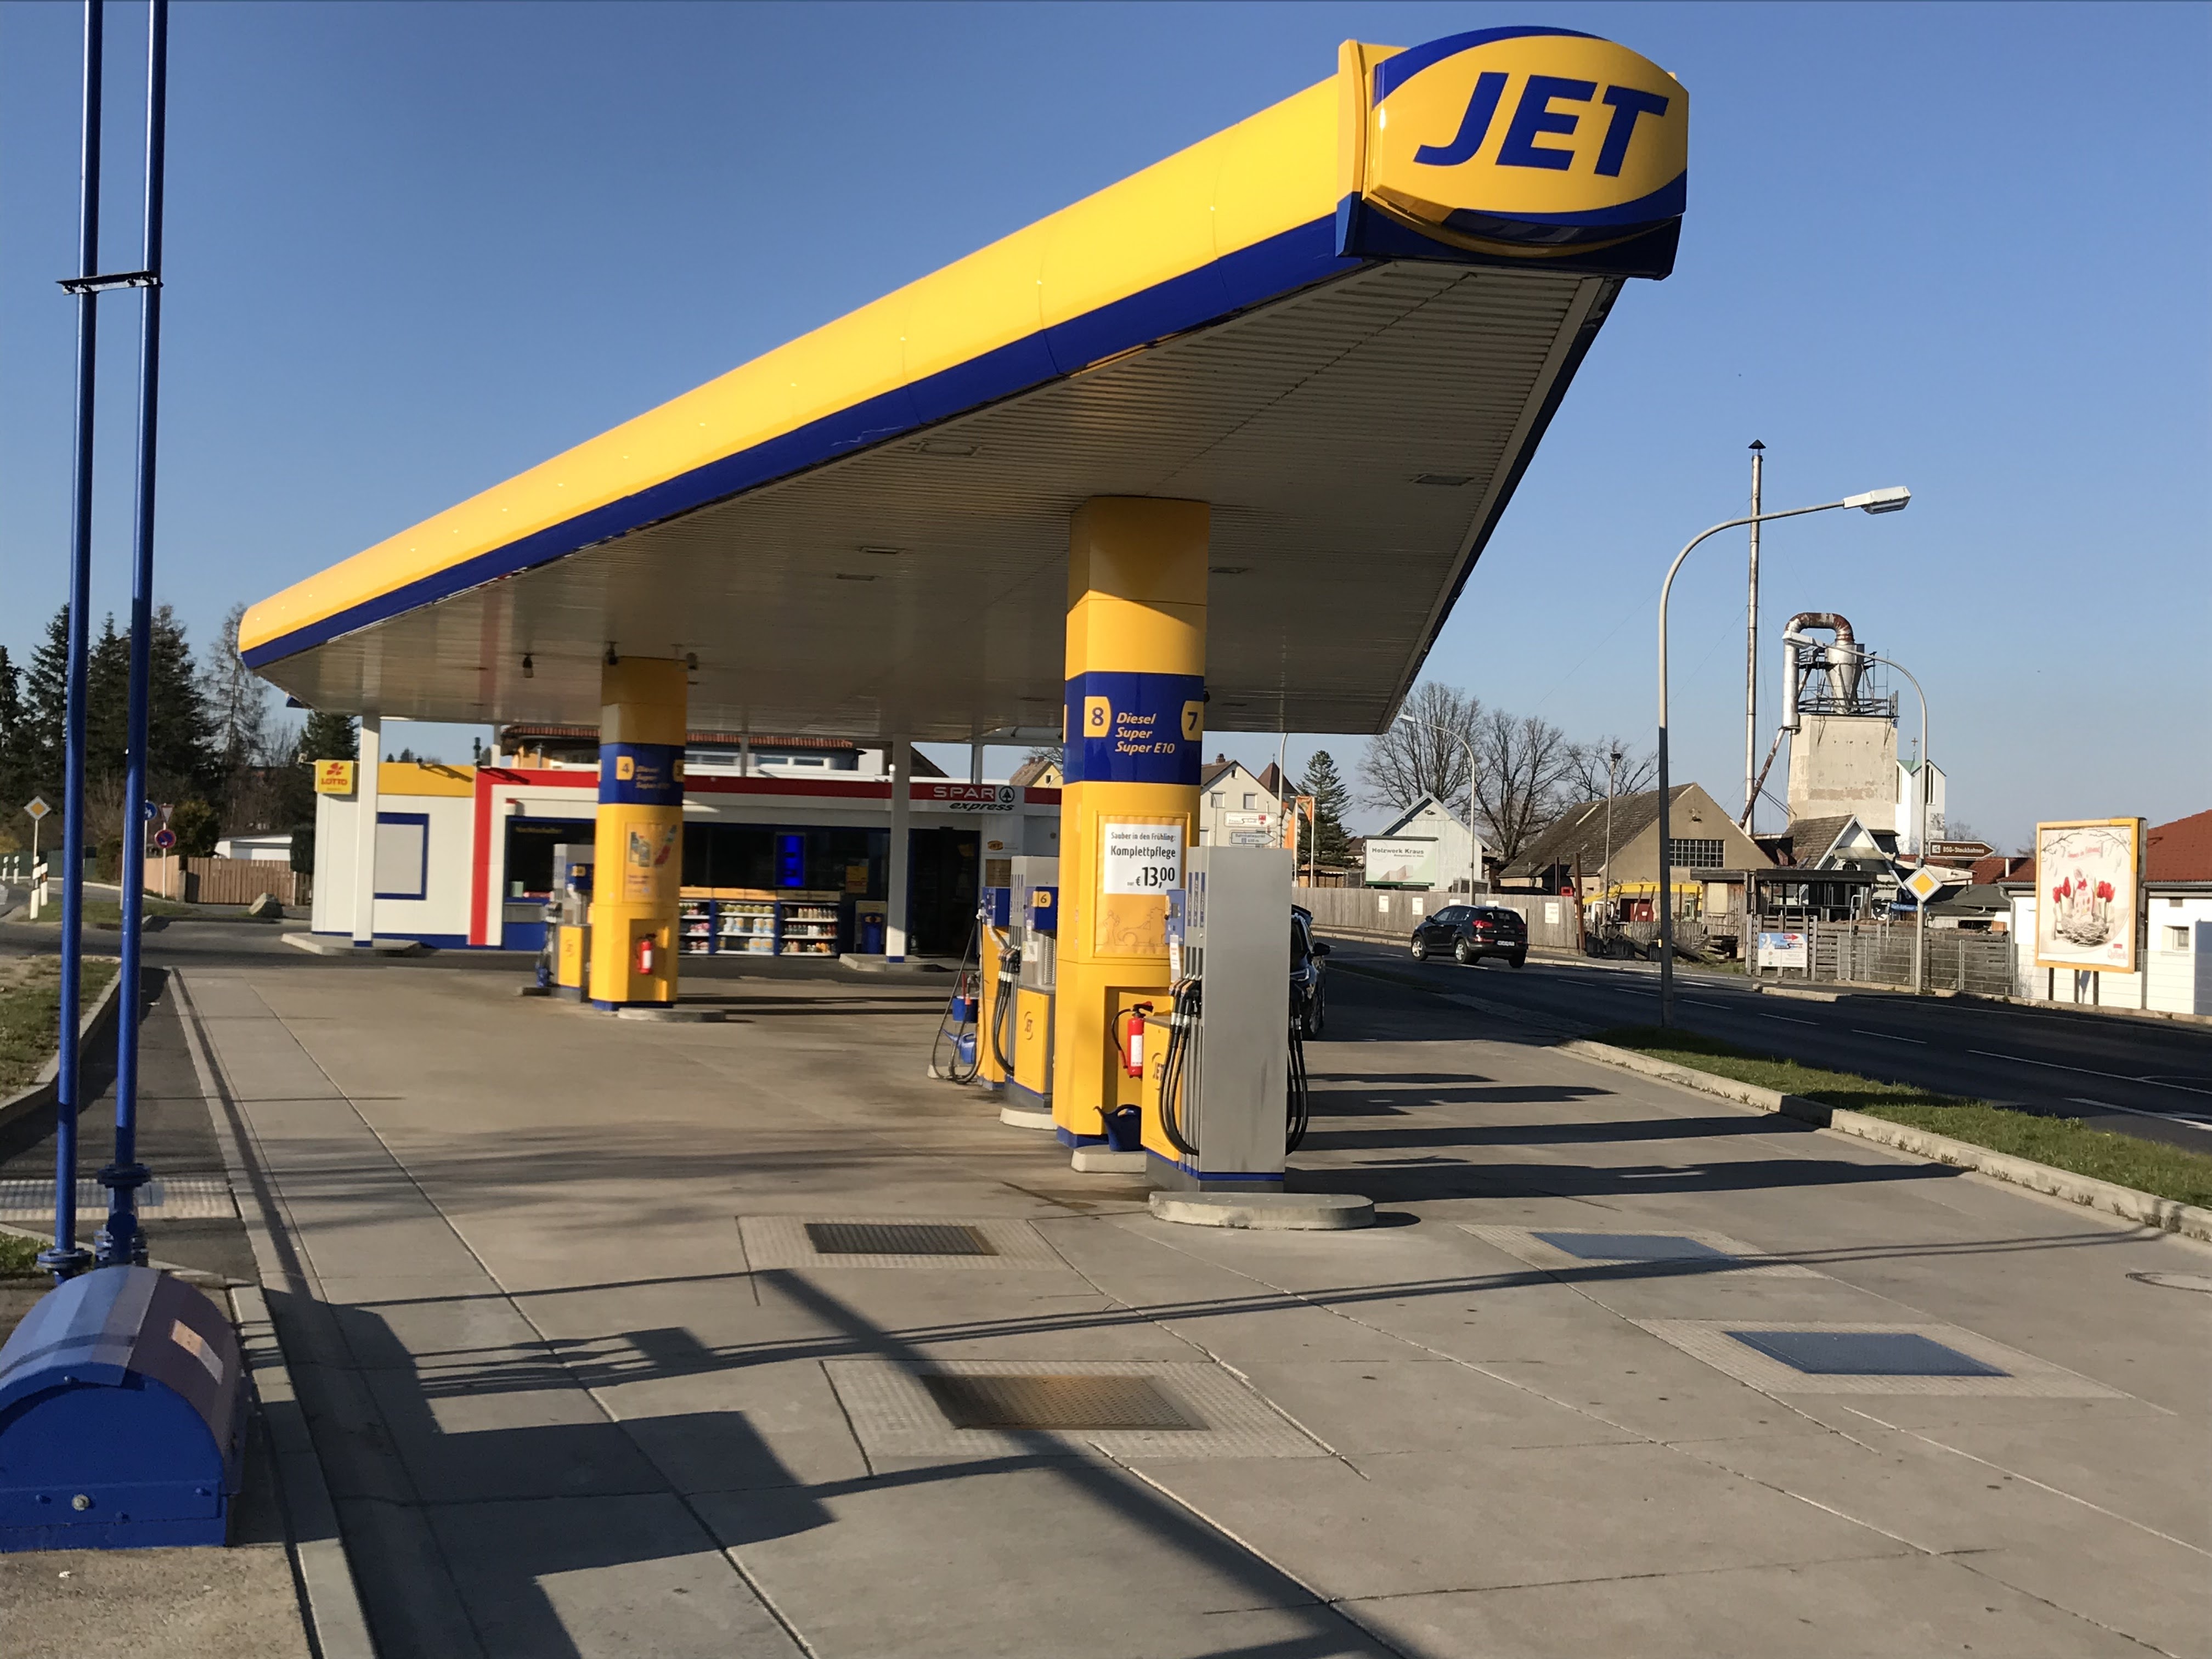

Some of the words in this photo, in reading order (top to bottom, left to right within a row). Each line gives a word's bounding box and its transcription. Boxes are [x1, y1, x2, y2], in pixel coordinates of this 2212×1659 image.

[1413, 71, 1669, 177] JET
[1091, 707, 1104, 726] 8
[1116, 712, 1156, 725] Diesel
[1187, 712, 1198, 731] 7
[1115, 727, 1153, 741] Super
[1115, 741, 1152, 755] Super
[1153, 743, 1175, 754] E10
[622, 763, 630, 774] 4
[933, 787, 994, 799] SPAR
[949, 803, 1014, 811] express
[1111, 845, 1176, 860] Komplettpflege
[1136, 876, 1141, 886] €
[1142, 867, 1175, 888] 13,00
[1040, 894, 1047, 904] 6
